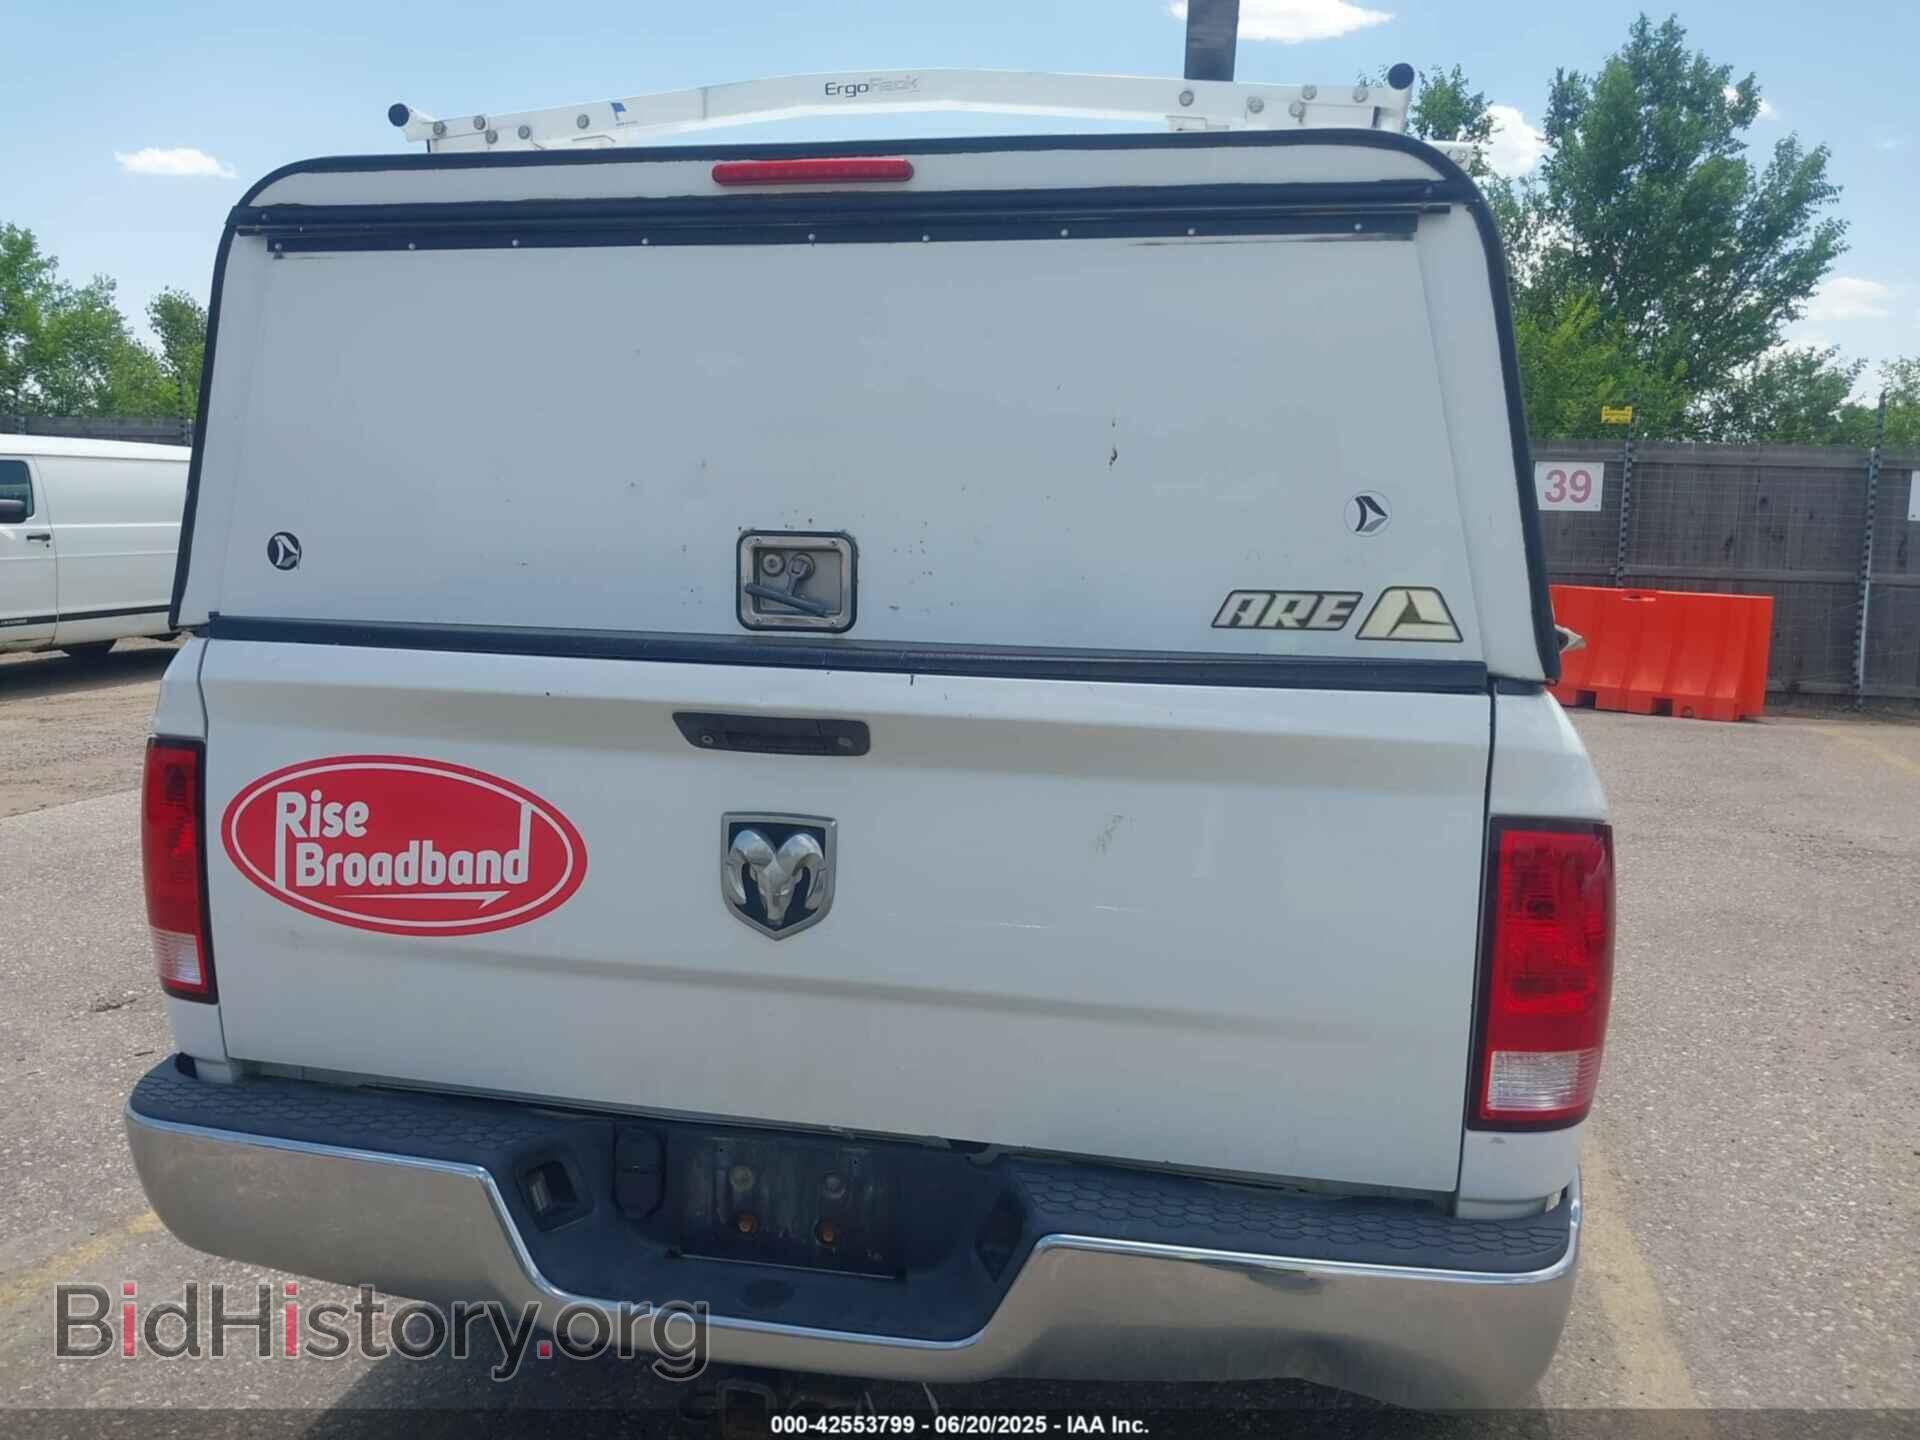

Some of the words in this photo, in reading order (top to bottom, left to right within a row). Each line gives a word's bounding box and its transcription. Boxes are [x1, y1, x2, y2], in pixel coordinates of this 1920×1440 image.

[1544, 469, 1592, 503] 39
[1211, 590, 1364, 631] ARE
[295, 801, 532, 886] Broadband
